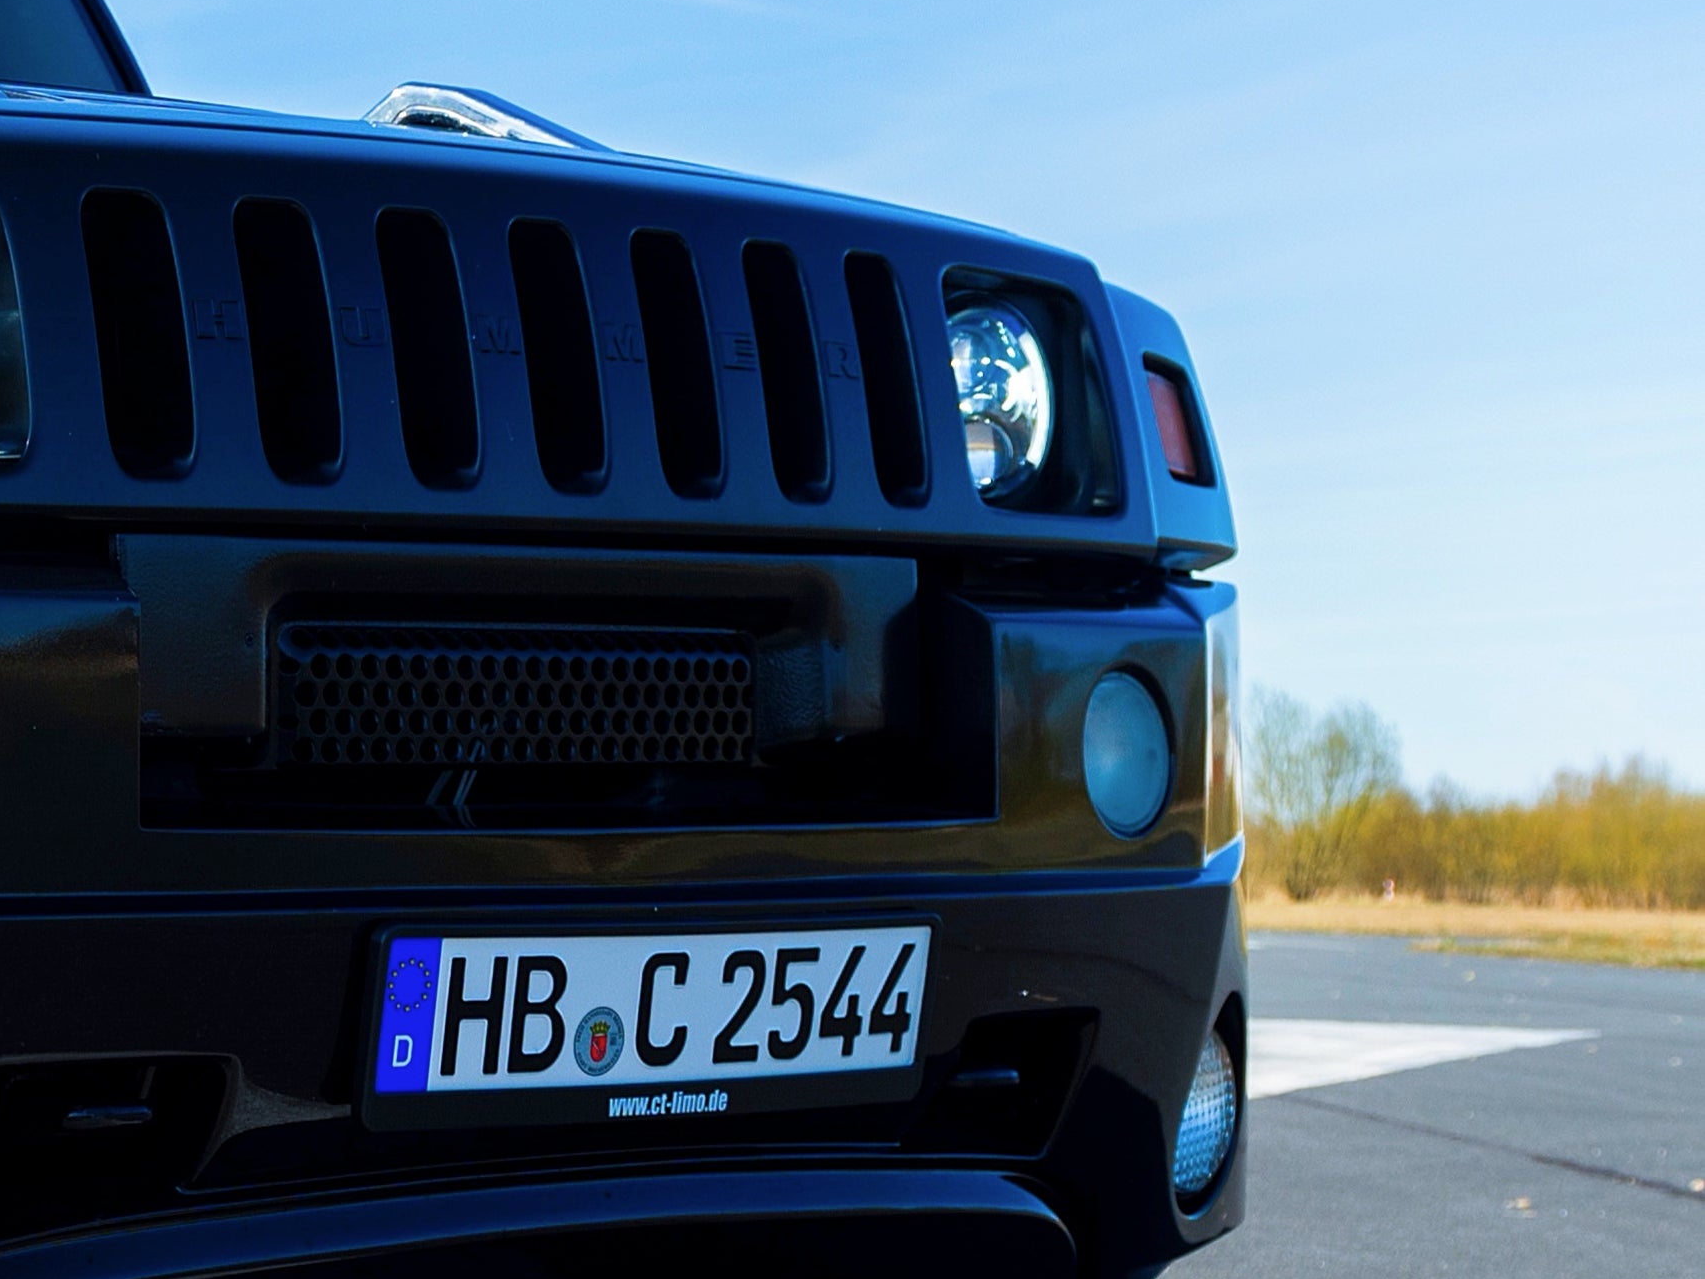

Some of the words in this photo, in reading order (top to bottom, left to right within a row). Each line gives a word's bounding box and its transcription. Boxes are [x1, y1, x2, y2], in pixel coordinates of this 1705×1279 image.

[439, 954, 568, 1077] HB
[635, 951, 690, 1067] C
[712, 943, 917, 1064] 2544
[392, 1034, 414, 1068] D
[607, 1088, 729, 1118] www.ct-limo.de
